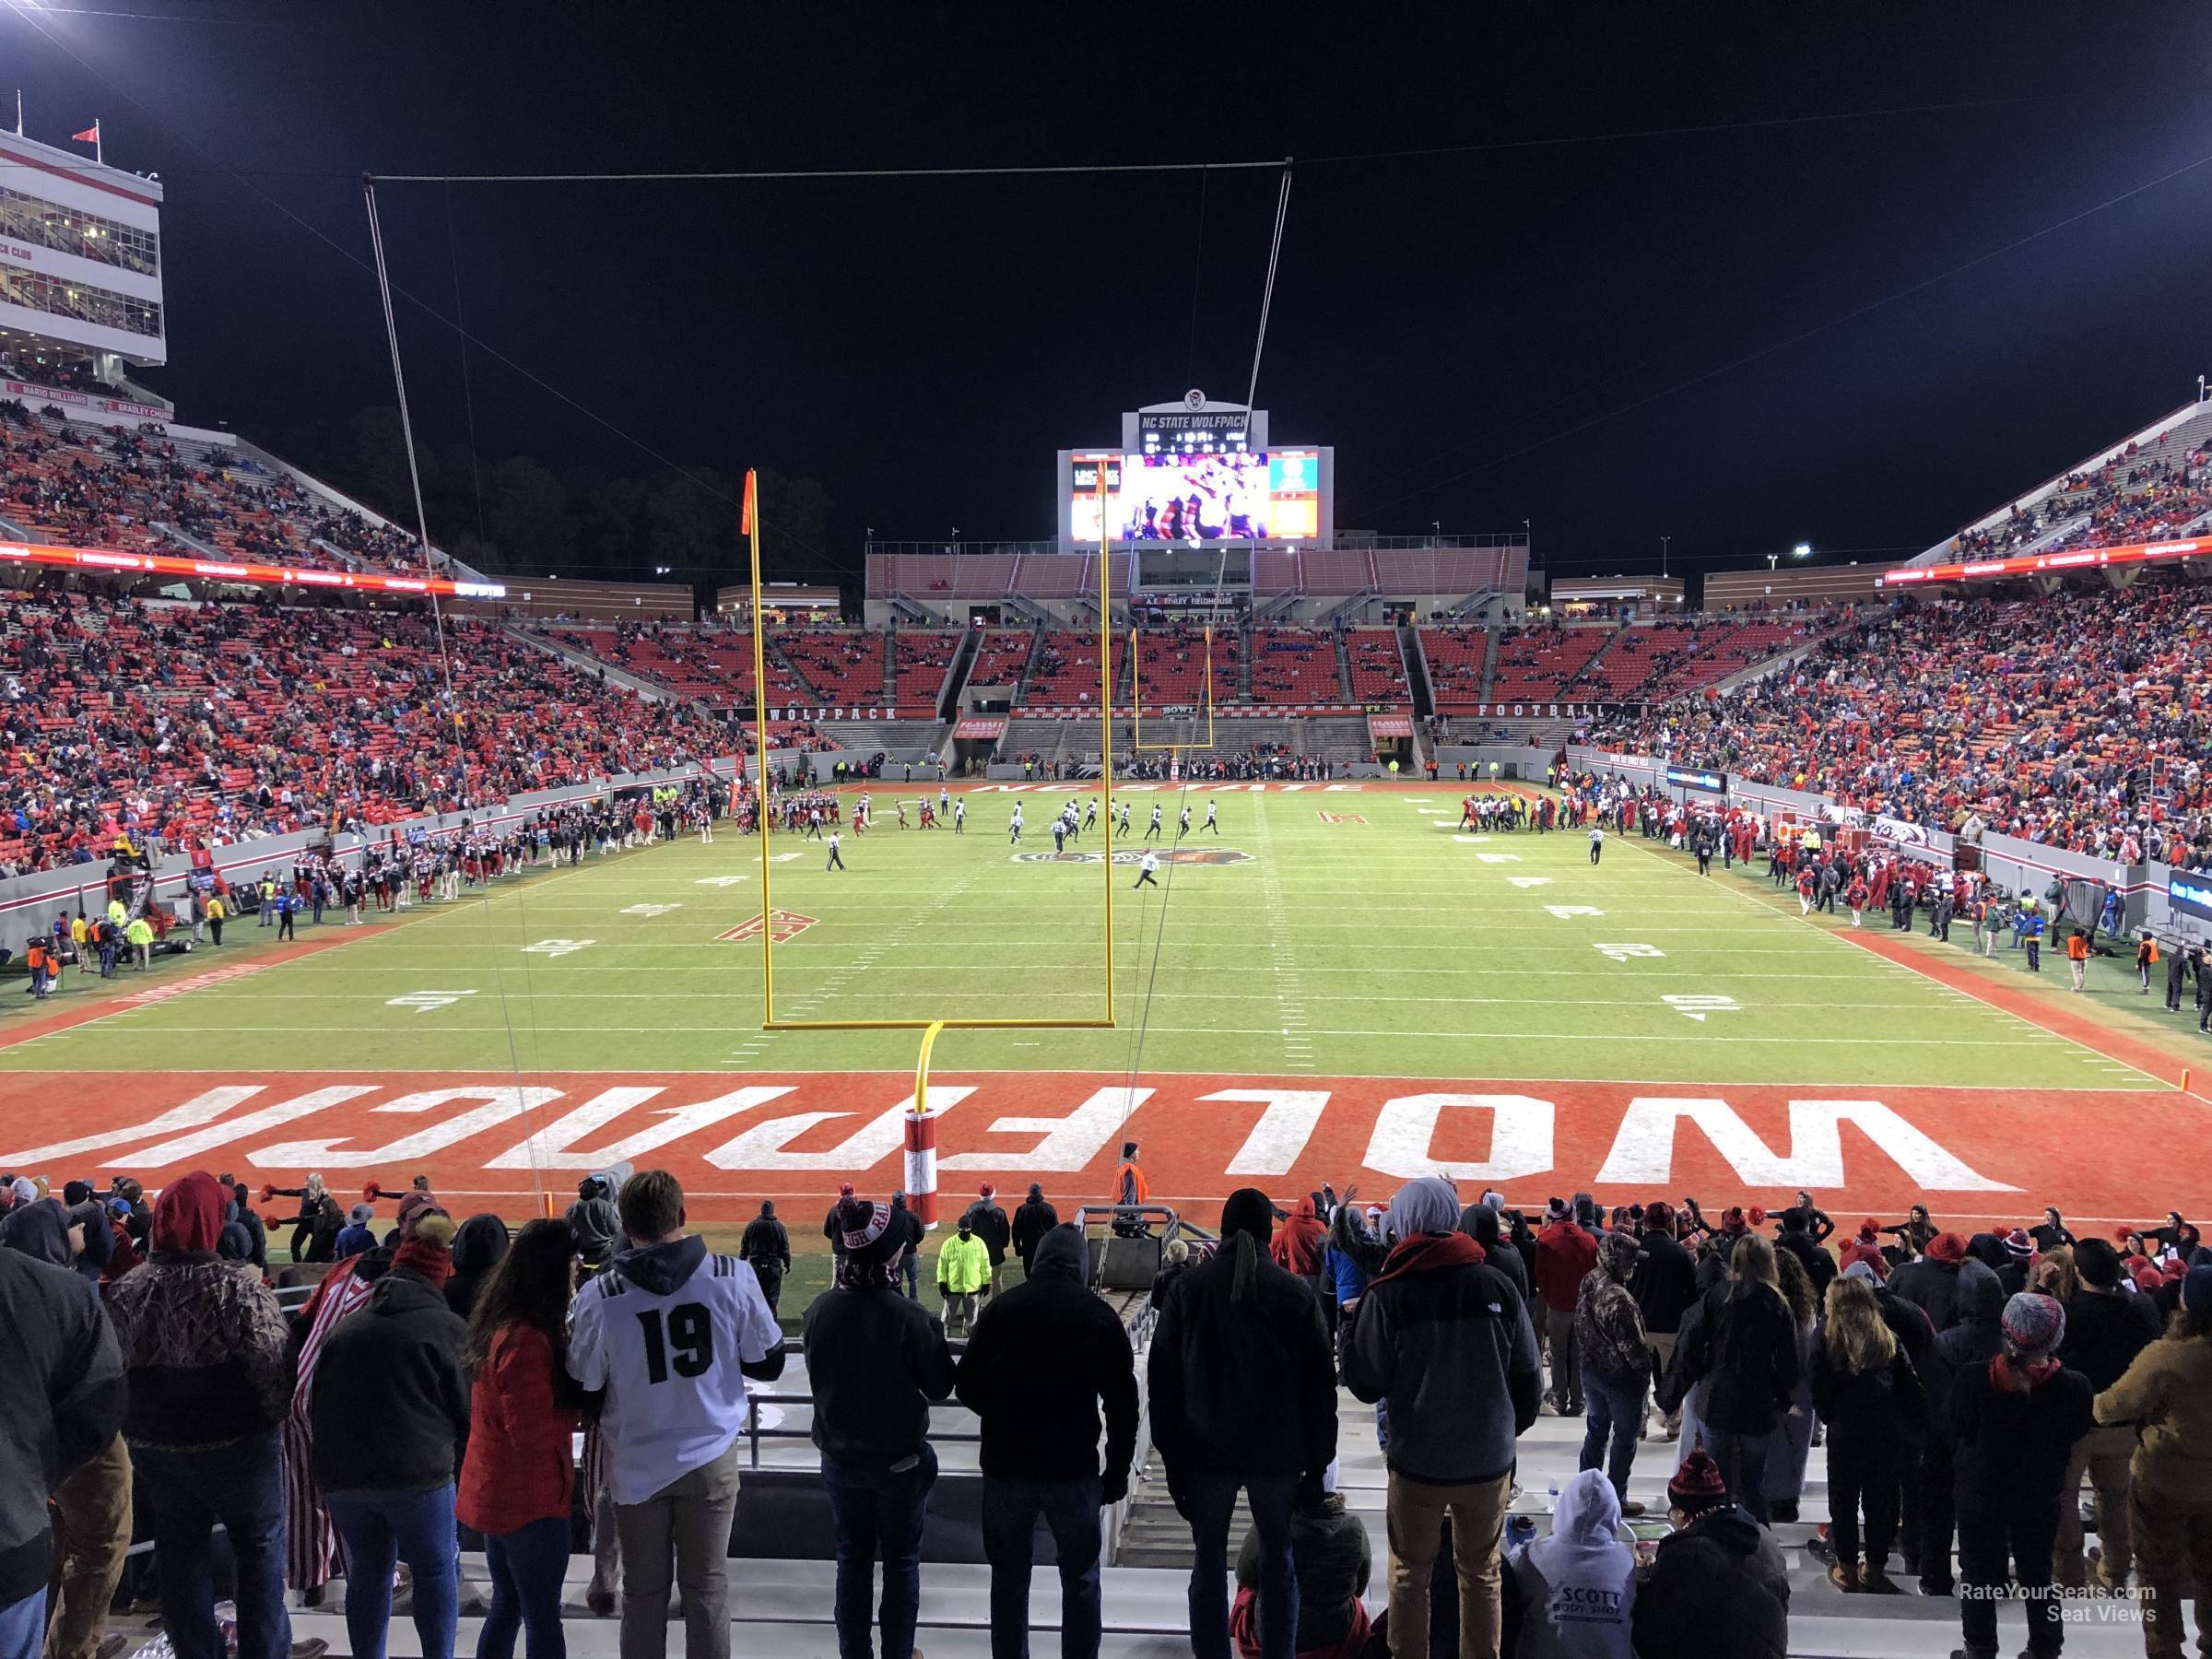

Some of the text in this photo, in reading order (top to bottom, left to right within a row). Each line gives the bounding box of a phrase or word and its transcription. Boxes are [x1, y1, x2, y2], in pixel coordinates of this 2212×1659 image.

[12, 246, 31, 260] CLUB
[23, 385, 87, 406] MARIO WILLIAMS
[118, 403, 173, 420] BRADLEY CHUBB
[1142, 417, 1157, 429] NC
[1159, 417, 1190, 429] STATE
[770, 708, 896, 721] WOLFPACK
[1162, 706, 1196, 714] BOWL
[1478, 704, 1605, 717] FOOTBALL
[1112, 783, 1365, 792] STATE
[0, 1085, 2028, 1192] WOLFPACK
[636, 1302, 713, 1384] 19
[1562, 1587, 1620, 1606] SCOTT
[1552, 1603, 1585, 1612] BODY
